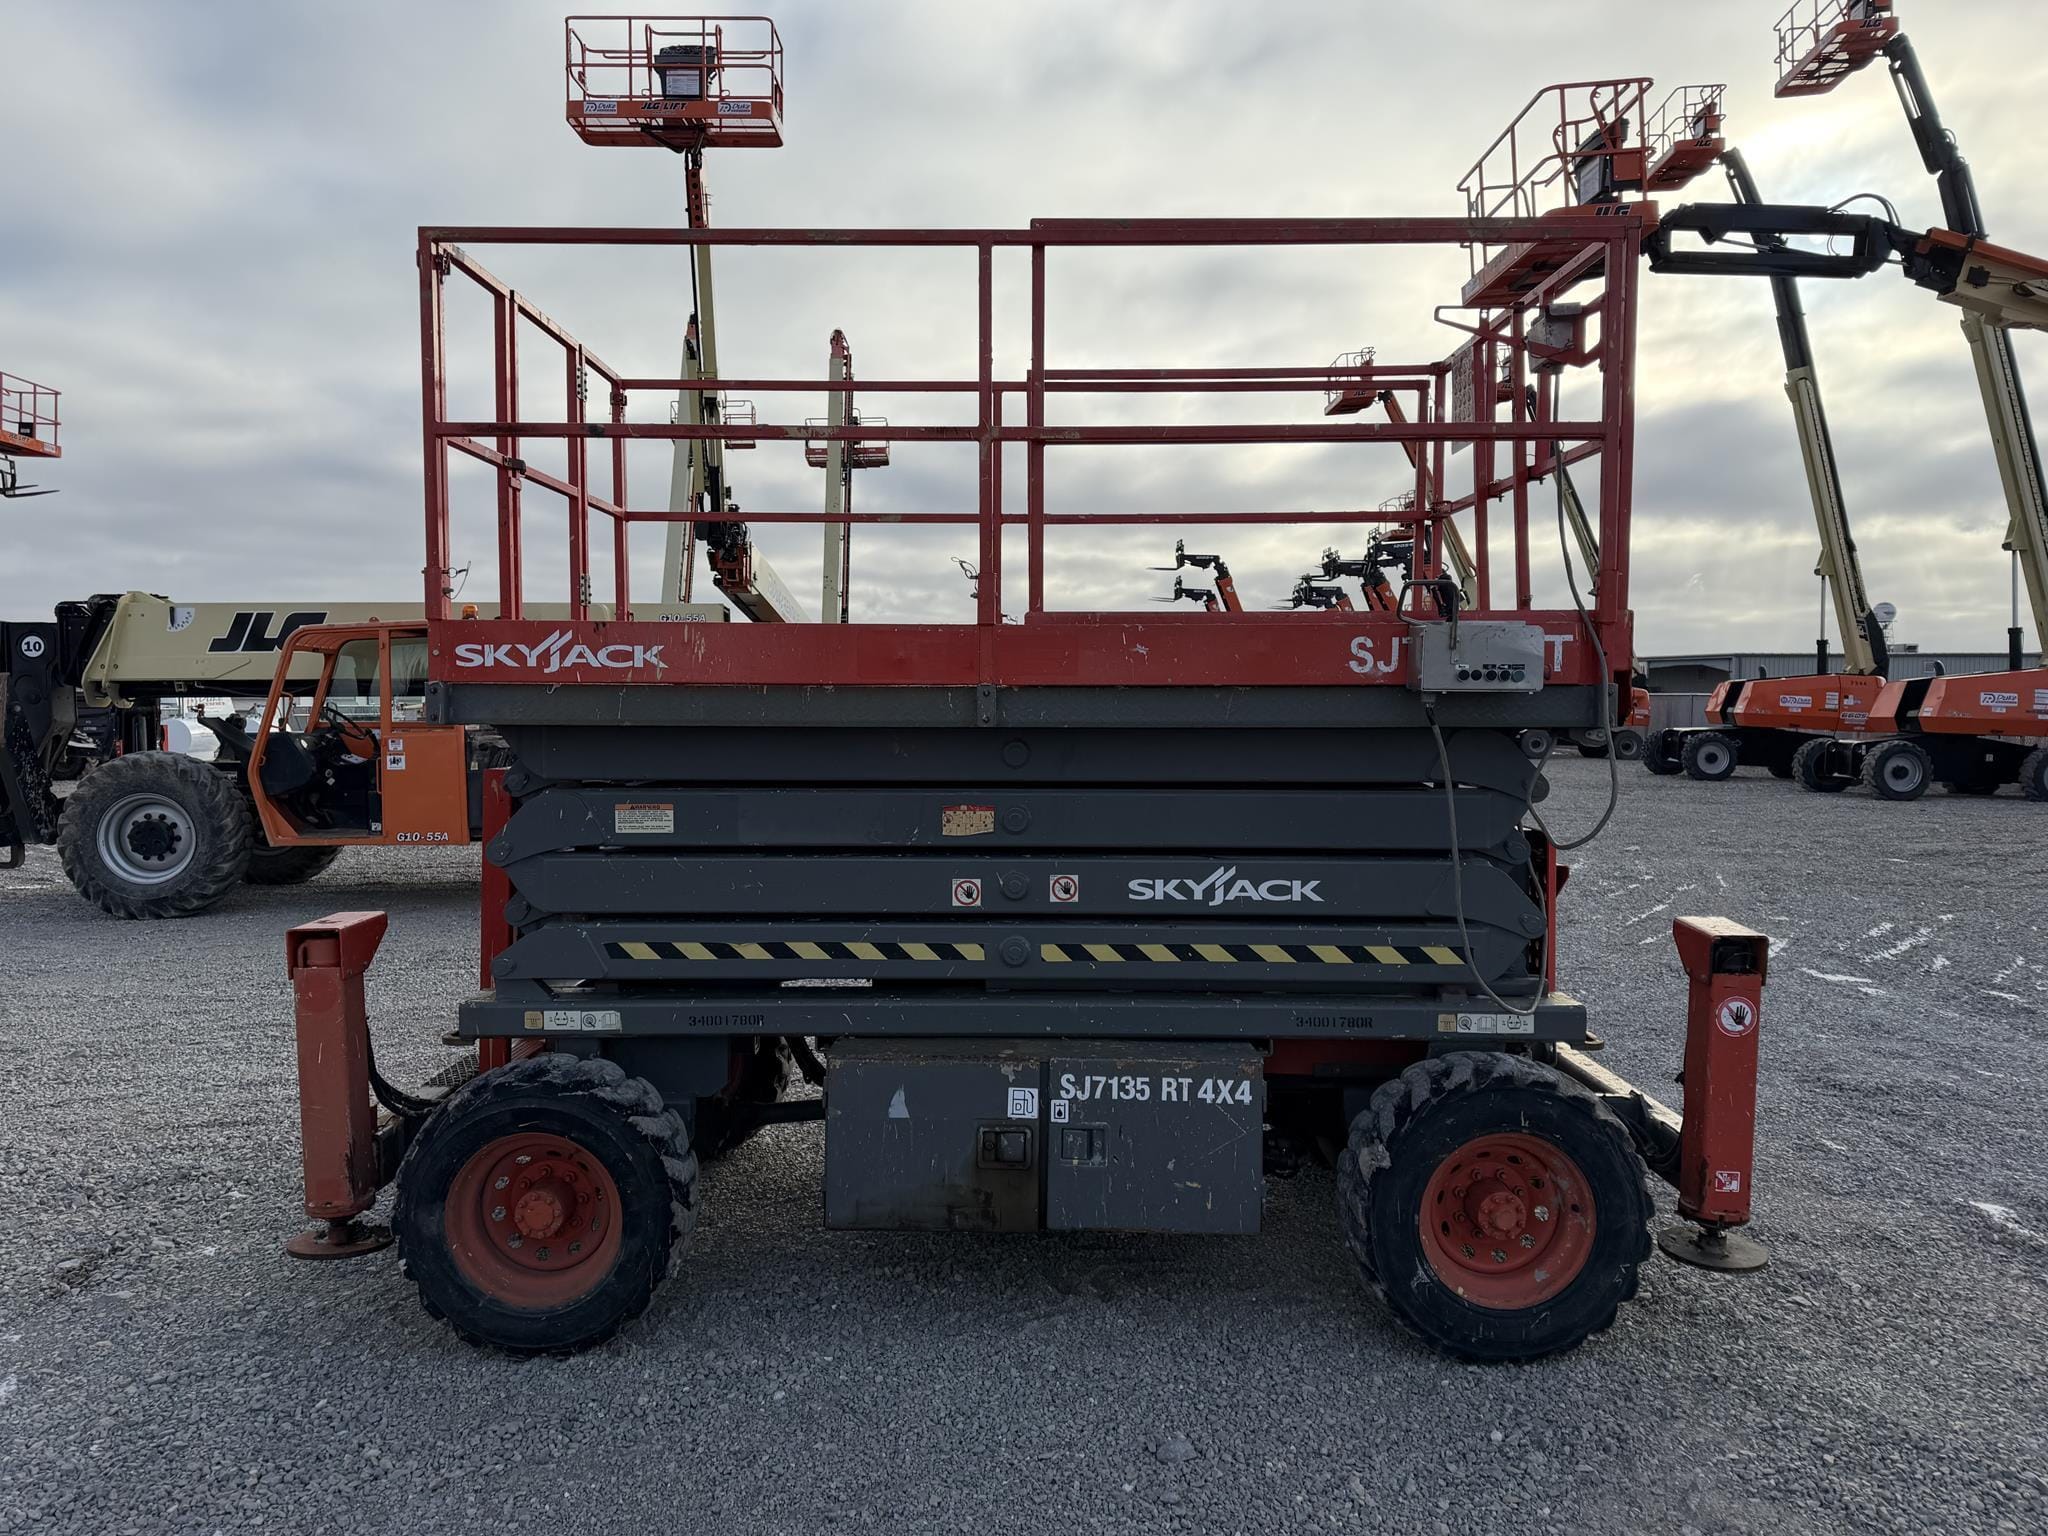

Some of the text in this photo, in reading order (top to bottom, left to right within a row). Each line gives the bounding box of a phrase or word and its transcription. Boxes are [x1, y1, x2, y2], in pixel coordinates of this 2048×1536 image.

[641, 102, 688, 110] JLG LIFT
[24, 641, 42, 652] 10
[455, 629, 669, 673] SKYJACK
[1349, 636, 1412, 673] SJ
[397, 832, 449, 842] G10-55A
[1128, 865, 1325, 907] SKYJACK
[1060, 1074, 1253, 1104] SJ7135 RT 4X4
